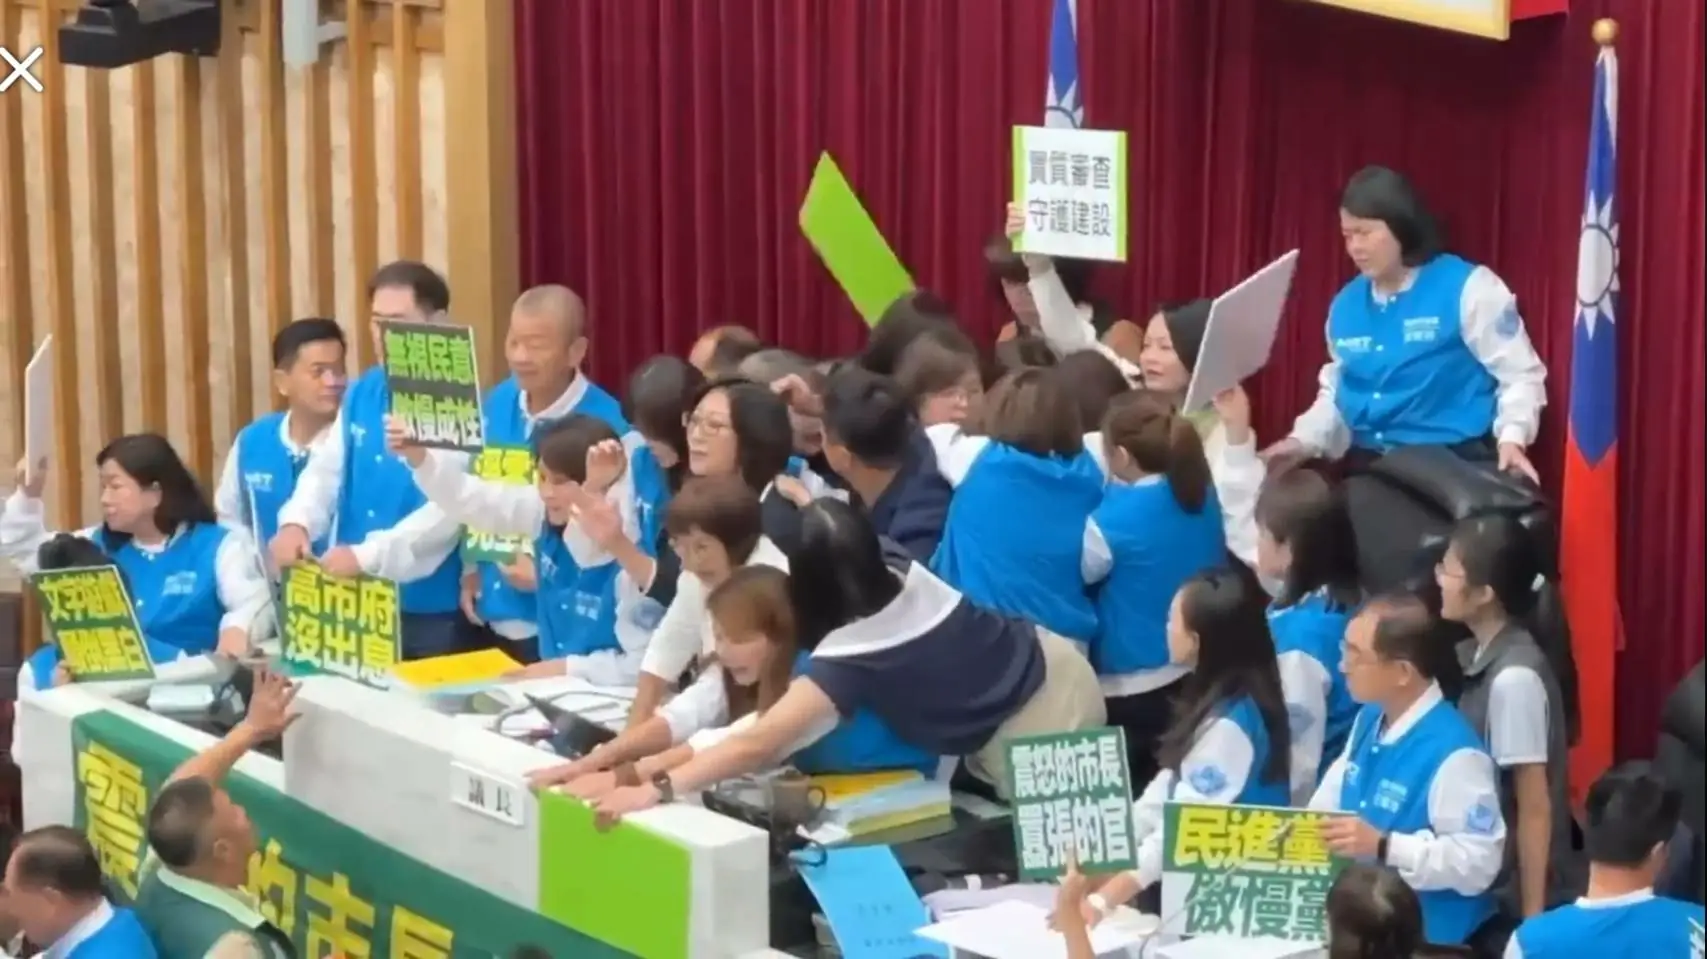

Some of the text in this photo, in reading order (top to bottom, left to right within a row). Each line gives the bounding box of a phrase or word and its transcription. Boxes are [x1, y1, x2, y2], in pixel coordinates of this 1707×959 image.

[1029, 197, 1111, 236] 守護建設
[385, 329, 475, 385] 無視民意
[286, 563, 394, 635] 高市府
[285, 610, 394, 686] 沒出息
[468, 777, 512, 816] 議長
[1011, 736, 1123, 798] 震怒的市長
[79, 740, 454, 959] 震的市
[1018, 793, 1130, 869] 囂張的官
[1174, 807, 1332, 876] 民進黨
[1185, 870, 1333, 942] 傲慢黨
